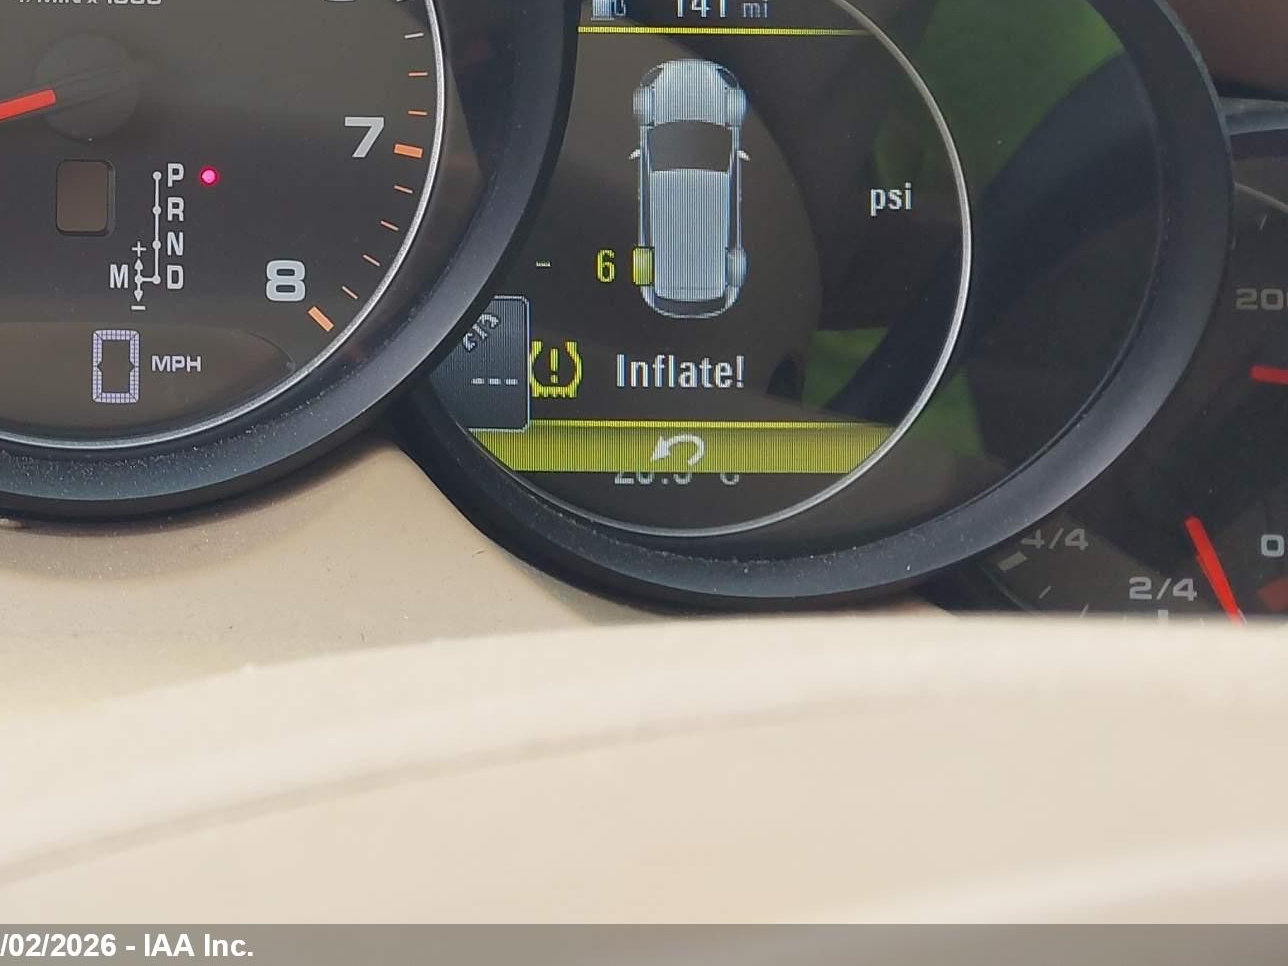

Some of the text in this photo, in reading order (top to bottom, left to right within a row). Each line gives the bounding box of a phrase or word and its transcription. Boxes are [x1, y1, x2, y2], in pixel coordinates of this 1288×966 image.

[742, 0, 768, 18] mi
[344, 117, 385, 158] 7
[168, 164, 185, 187] P
[168, 197, 185, 221] R
[870, 183, 912, 216] psi
[168, 232, 184, 256] N
[111, 266, 184, 290] M D
[596, 249, 616, 284] 6
[266, 260, 306, 302] 8
[1236, 288, 1288, 310] 20
[92, 330, 140, 403] 0
[151, 356, 202, 372] MPH
[616, 354, 745, 388] Inflate!
[1262, 535, 1285, 557] 0
[1129, 578, 1197, 601] 2/4
